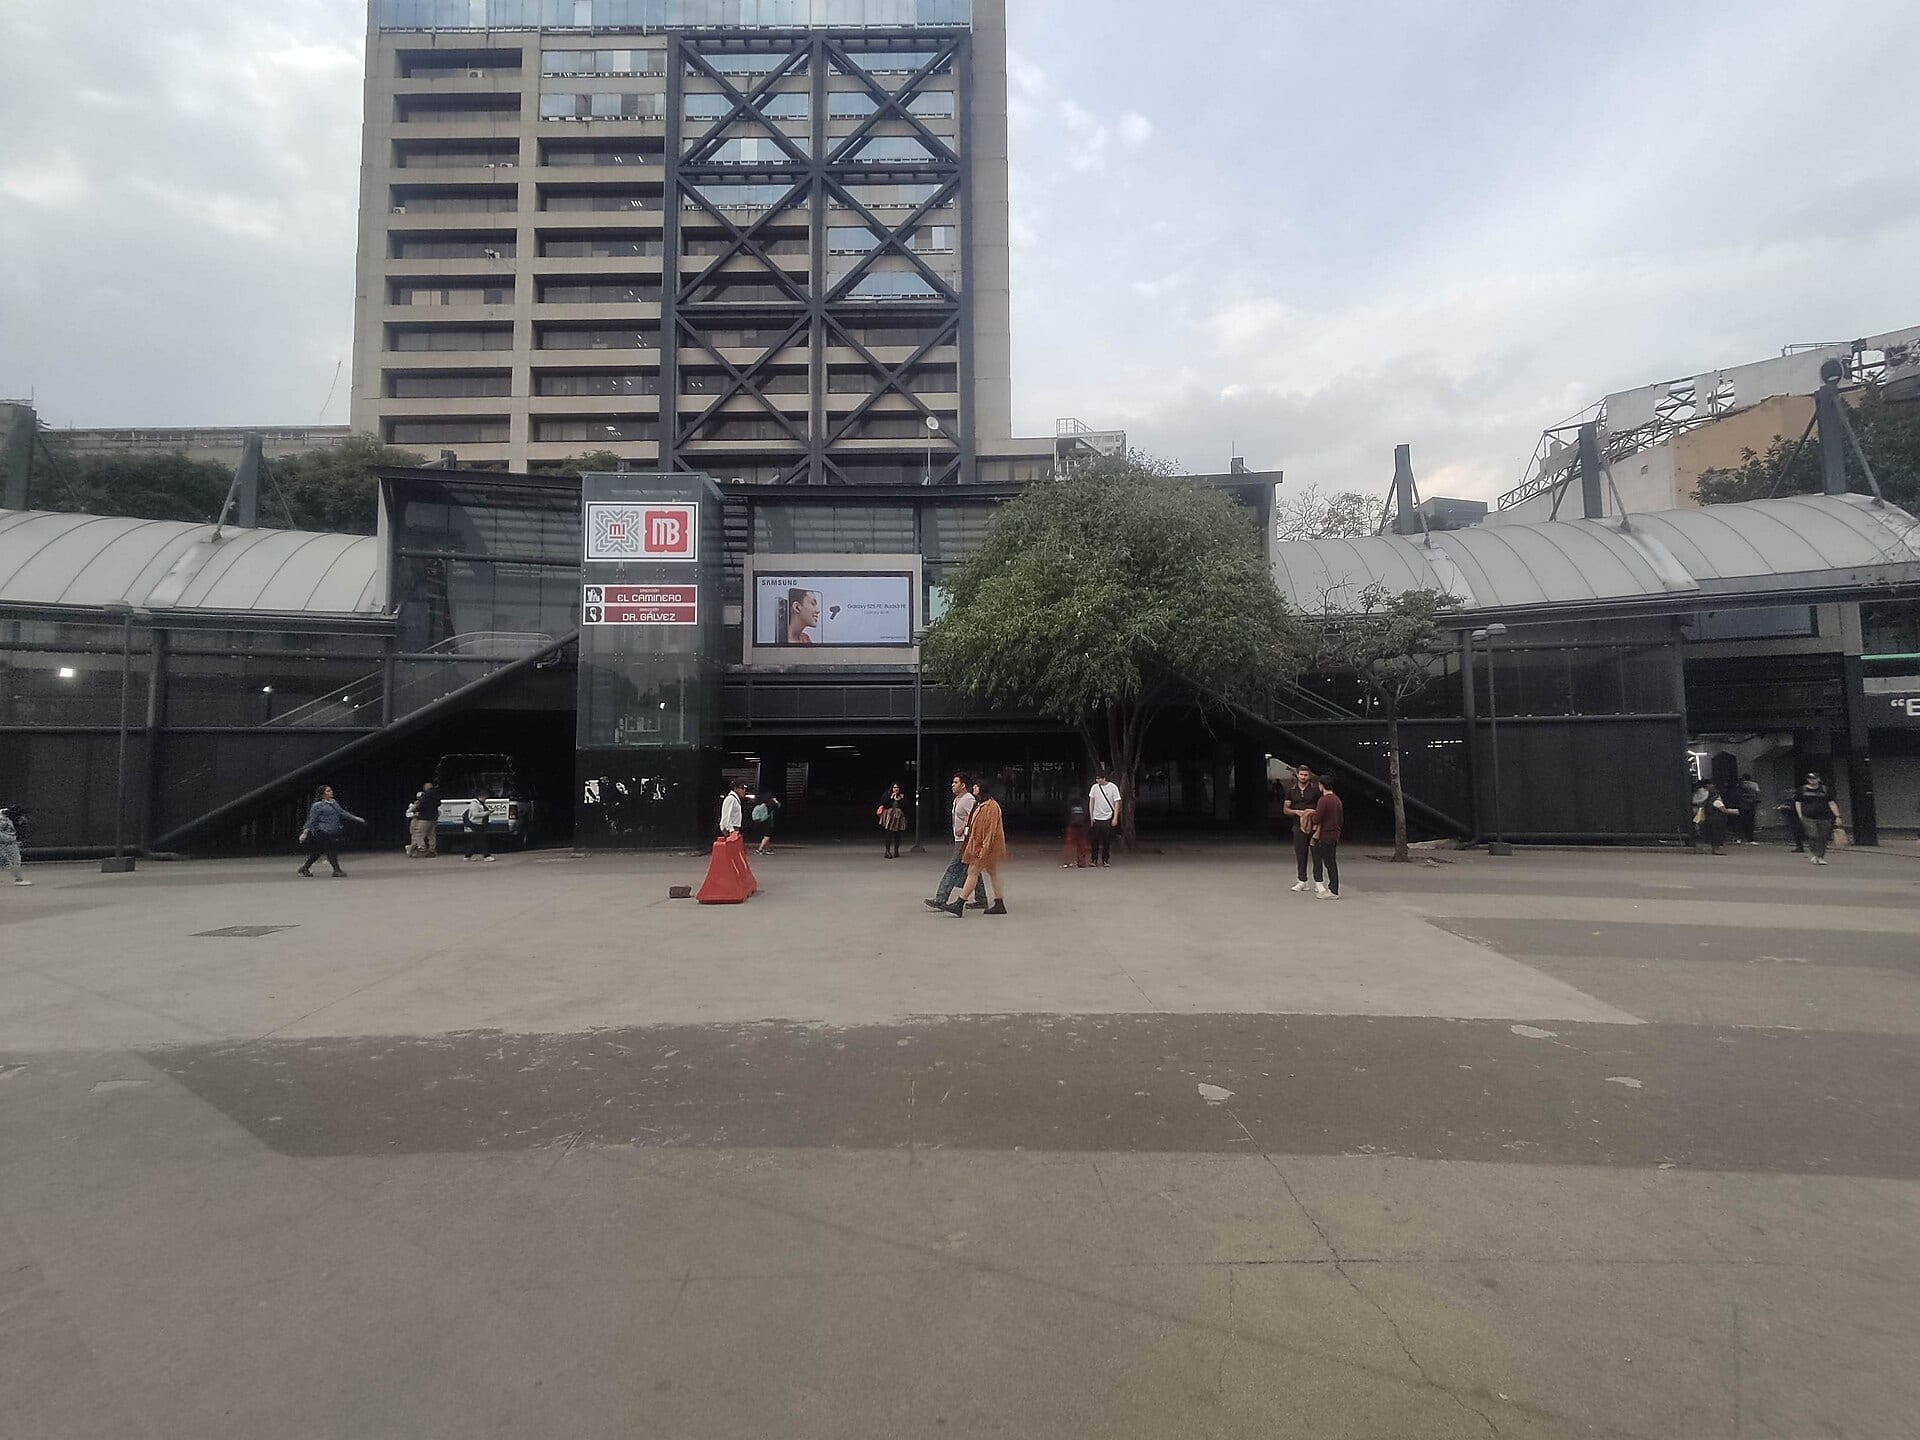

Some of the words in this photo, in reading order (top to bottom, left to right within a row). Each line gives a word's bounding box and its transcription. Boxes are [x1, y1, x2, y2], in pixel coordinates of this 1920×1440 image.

[617, 594, 630, 602] EL
[631, 594, 682, 602] CAMINERO
[622, 613, 637, 621] DR.
[640, 610, 676, 621] GÁLVEZ
